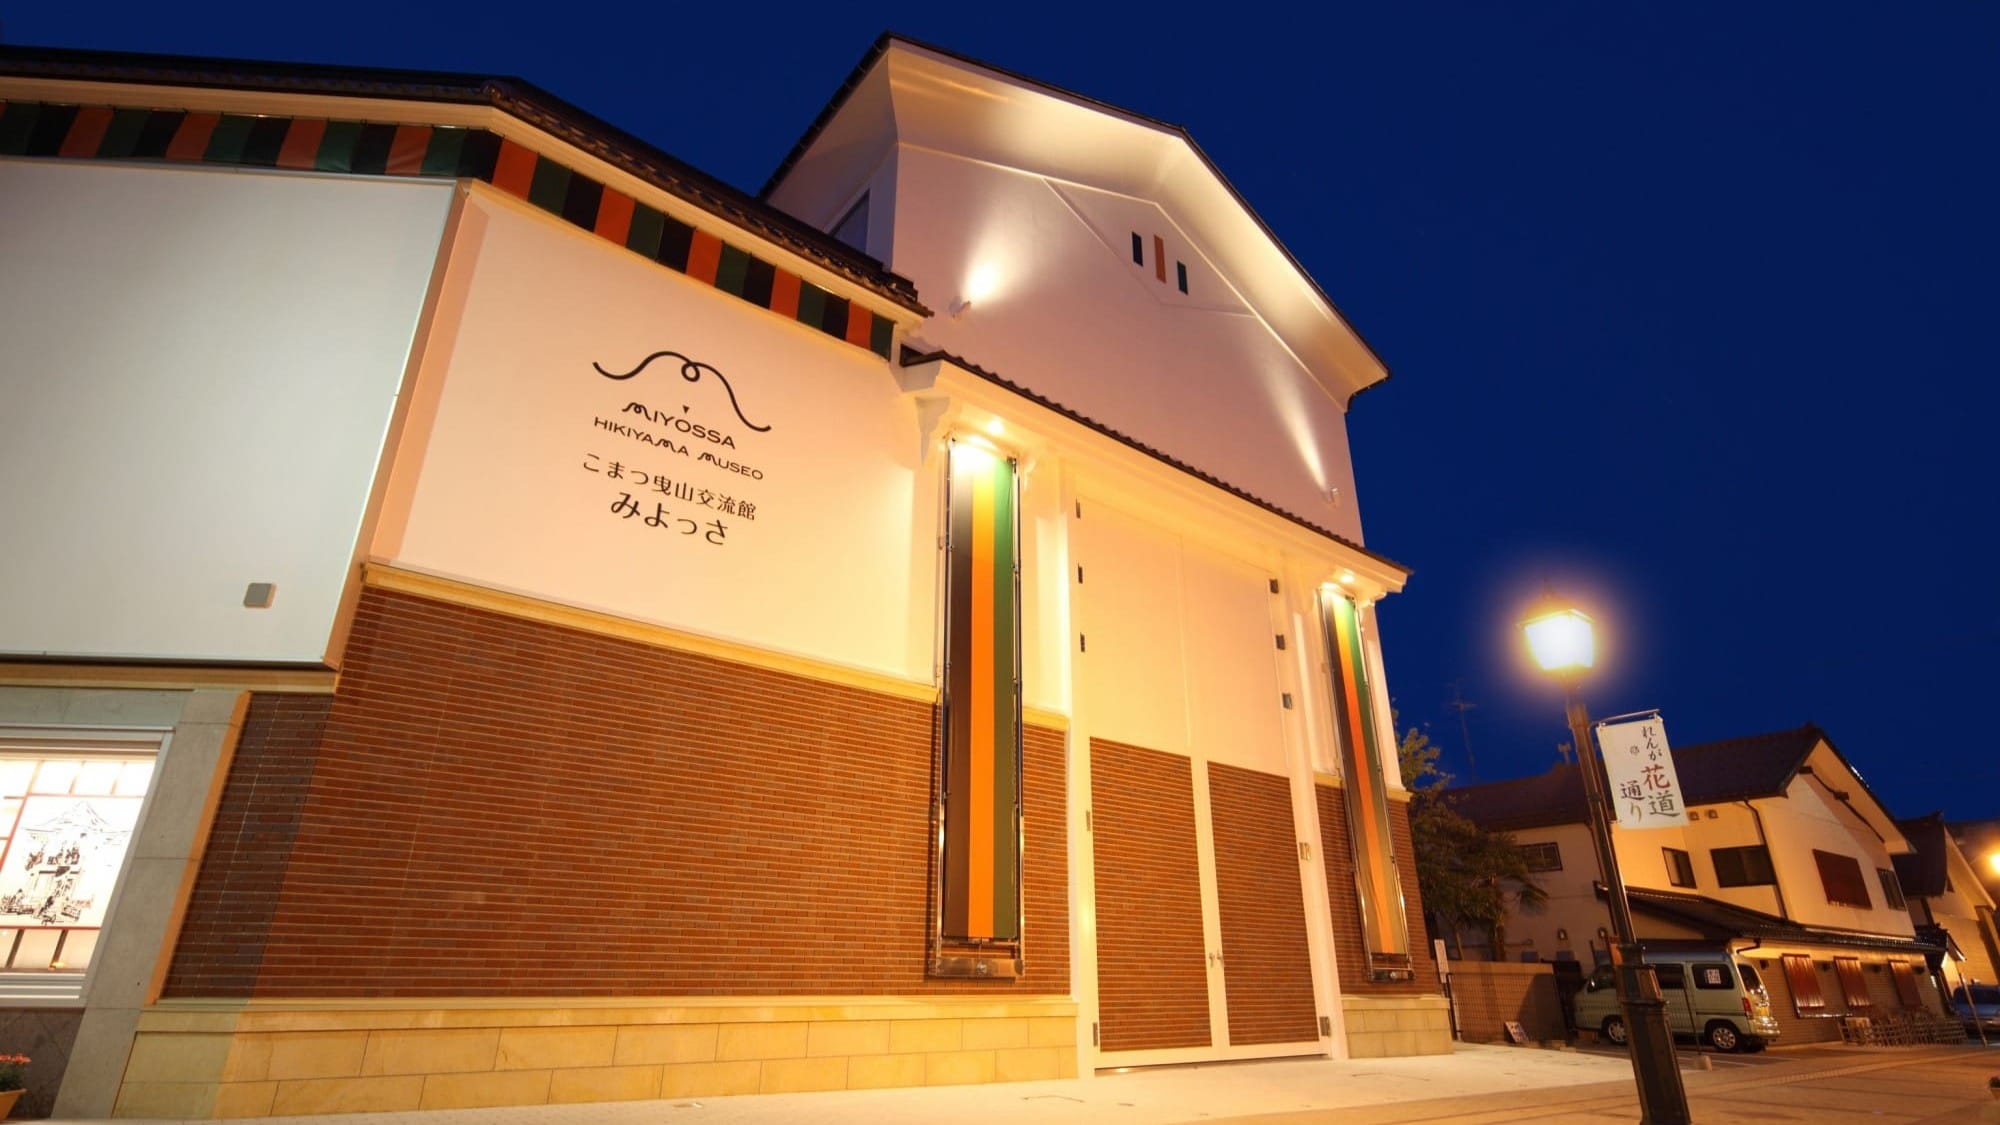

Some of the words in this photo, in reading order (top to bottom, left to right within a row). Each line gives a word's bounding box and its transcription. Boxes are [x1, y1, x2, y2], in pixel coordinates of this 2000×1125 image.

[594, 416, 689, 456] HIKIYAMA
[697, 452, 764, 480] MUSEO
[622, 402, 736, 450] MIYOSSA
[583, 453, 756, 520] こまつ曳山交流館
[610, 492, 728, 545] みよっさ
